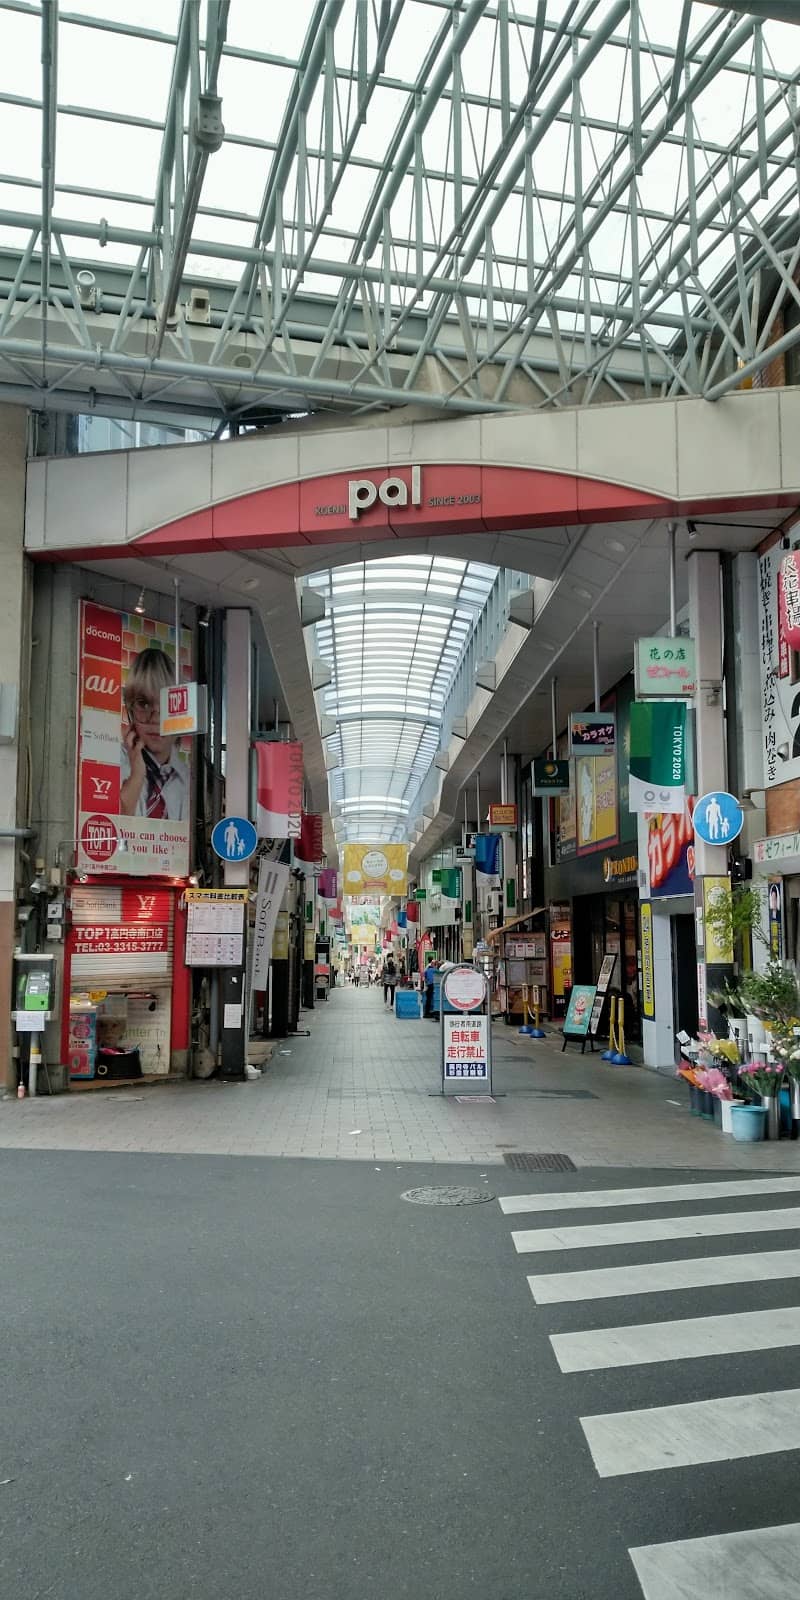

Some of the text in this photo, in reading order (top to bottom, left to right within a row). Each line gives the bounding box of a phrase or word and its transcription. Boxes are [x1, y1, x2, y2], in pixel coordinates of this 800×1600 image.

[348, 465, 421, 519] pal
[427, 495, 456, 507] SINCE
[457, 494, 481, 505] 2003
[86, 625, 121, 642] docomo
[649, 647, 686, 660] 花の店
[85, 675, 120, 695] au
[582, 725, 613, 741] カラオケ
[672, 725, 682, 780] TOKYO 2020
[90, 777, 112, 794] Y!
[287, 743, 303, 838] TOKYO 2020
[120, 828, 188, 843] You can choose
[132, 845, 148, 855] you
[152, 844, 169, 854] like
[254, 897, 272, 976] SoftBank
[75, 941, 164, 953] TEL:03-3315-3777
[452, 1030, 480, 1042] 自転車
[447, 1046, 485, 1058] 走行禁止
